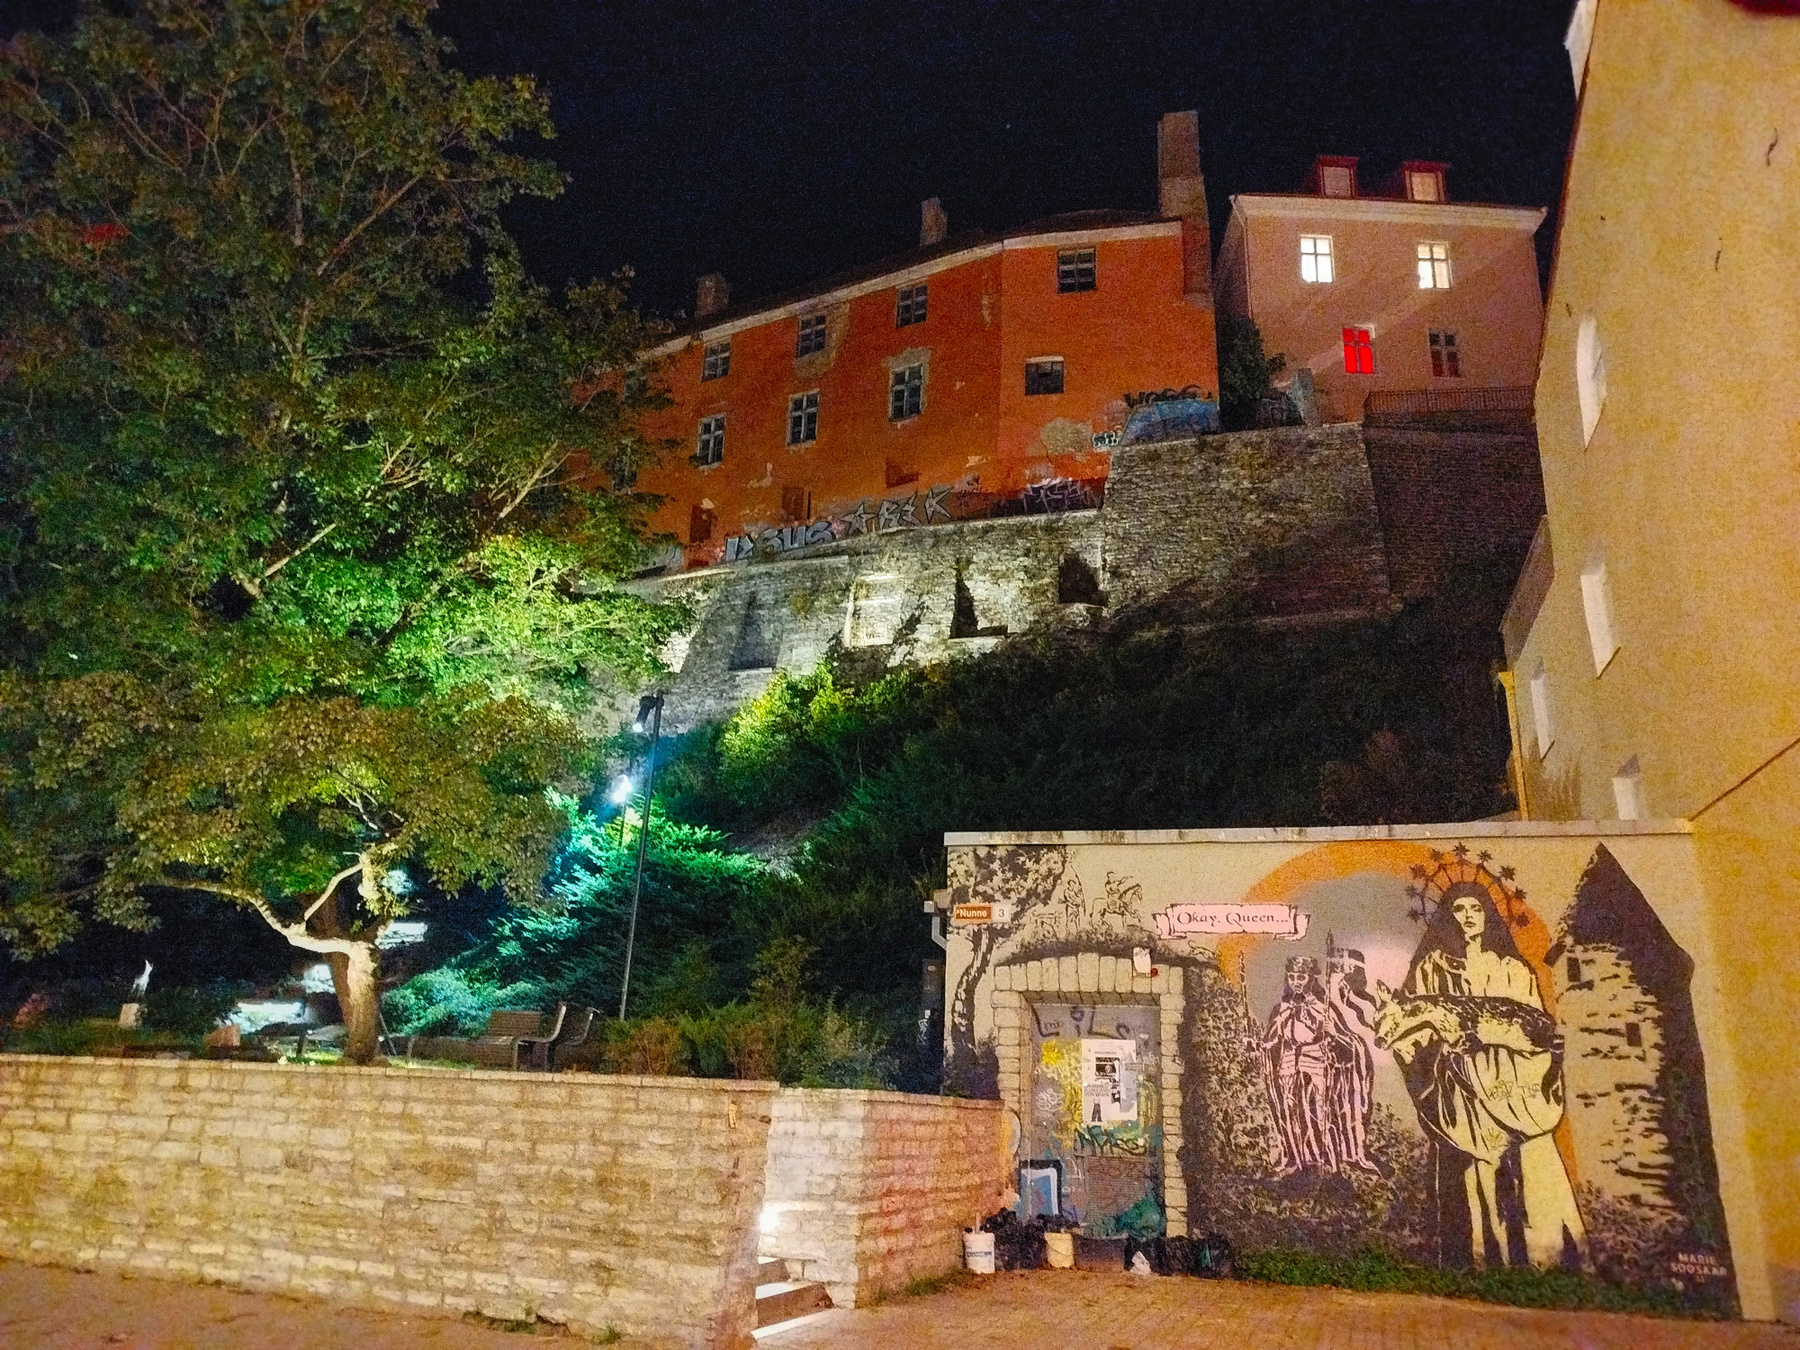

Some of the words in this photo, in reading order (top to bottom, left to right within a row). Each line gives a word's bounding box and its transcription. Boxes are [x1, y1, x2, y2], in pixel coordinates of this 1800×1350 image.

[998, 908, 1005, 918] 3
[1678, 1253, 1717, 1265] MARIE
[1670, 1262, 1727, 1276] SOOSAAR
